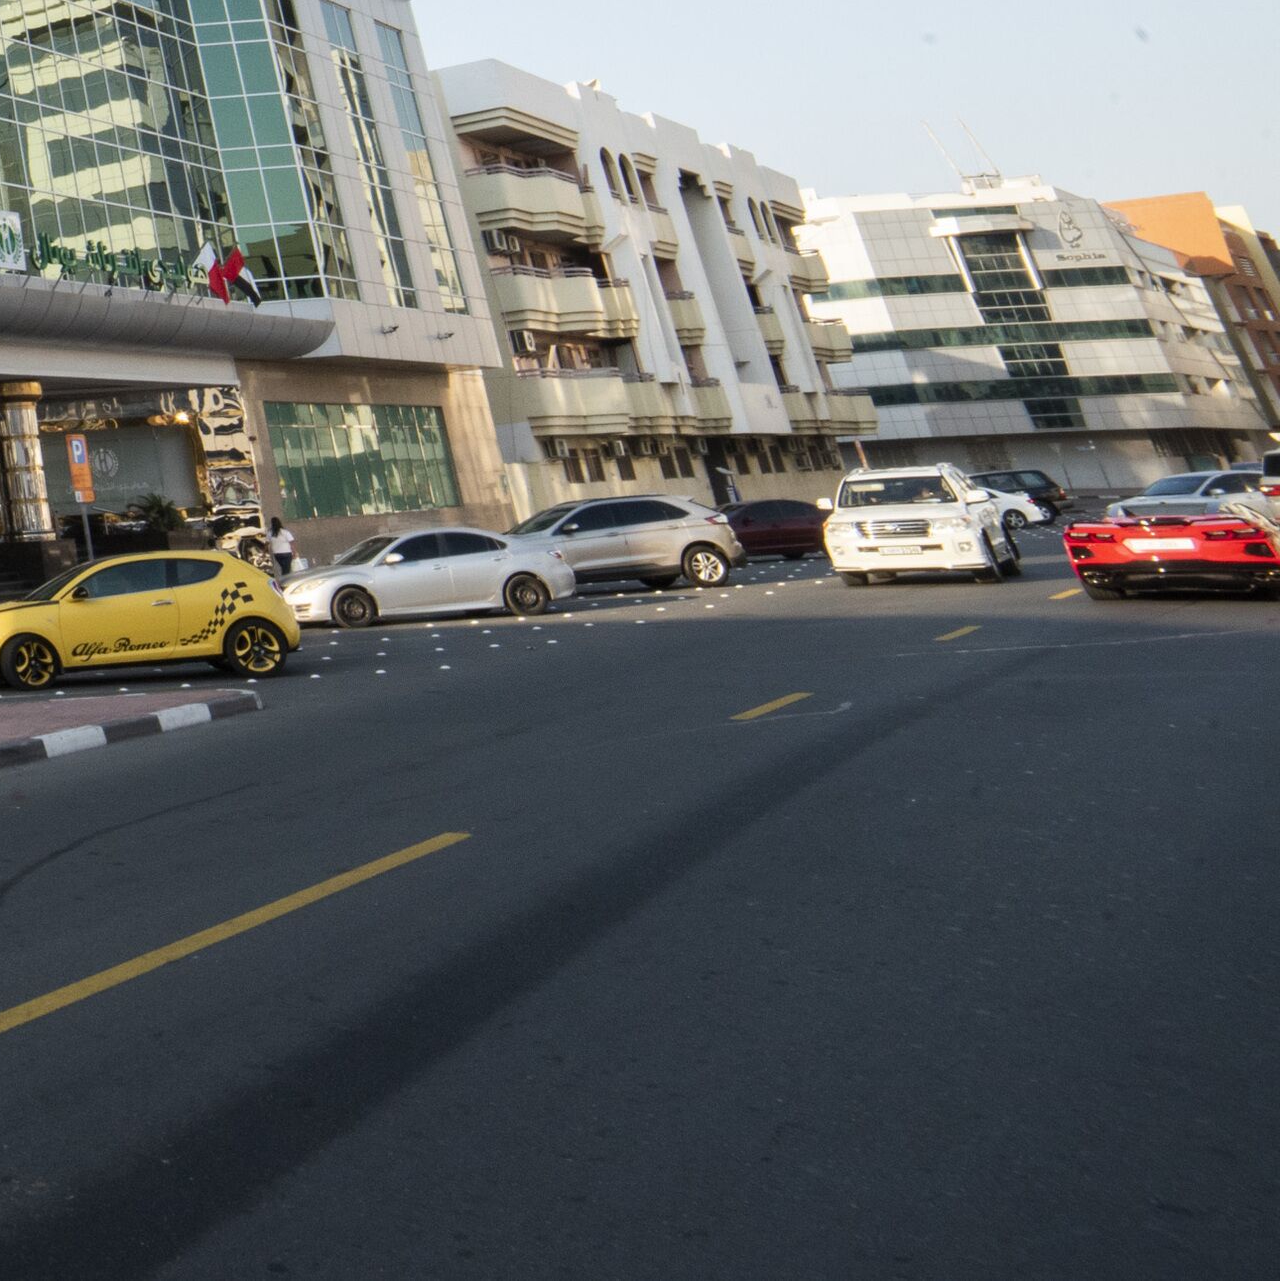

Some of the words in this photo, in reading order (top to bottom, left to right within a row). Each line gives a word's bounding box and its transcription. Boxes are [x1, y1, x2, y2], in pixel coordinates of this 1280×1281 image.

[71, 439, 83, 464] P
[71, 642, 112, 662] Alfa
[113, 637, 170, 653] Romeo
